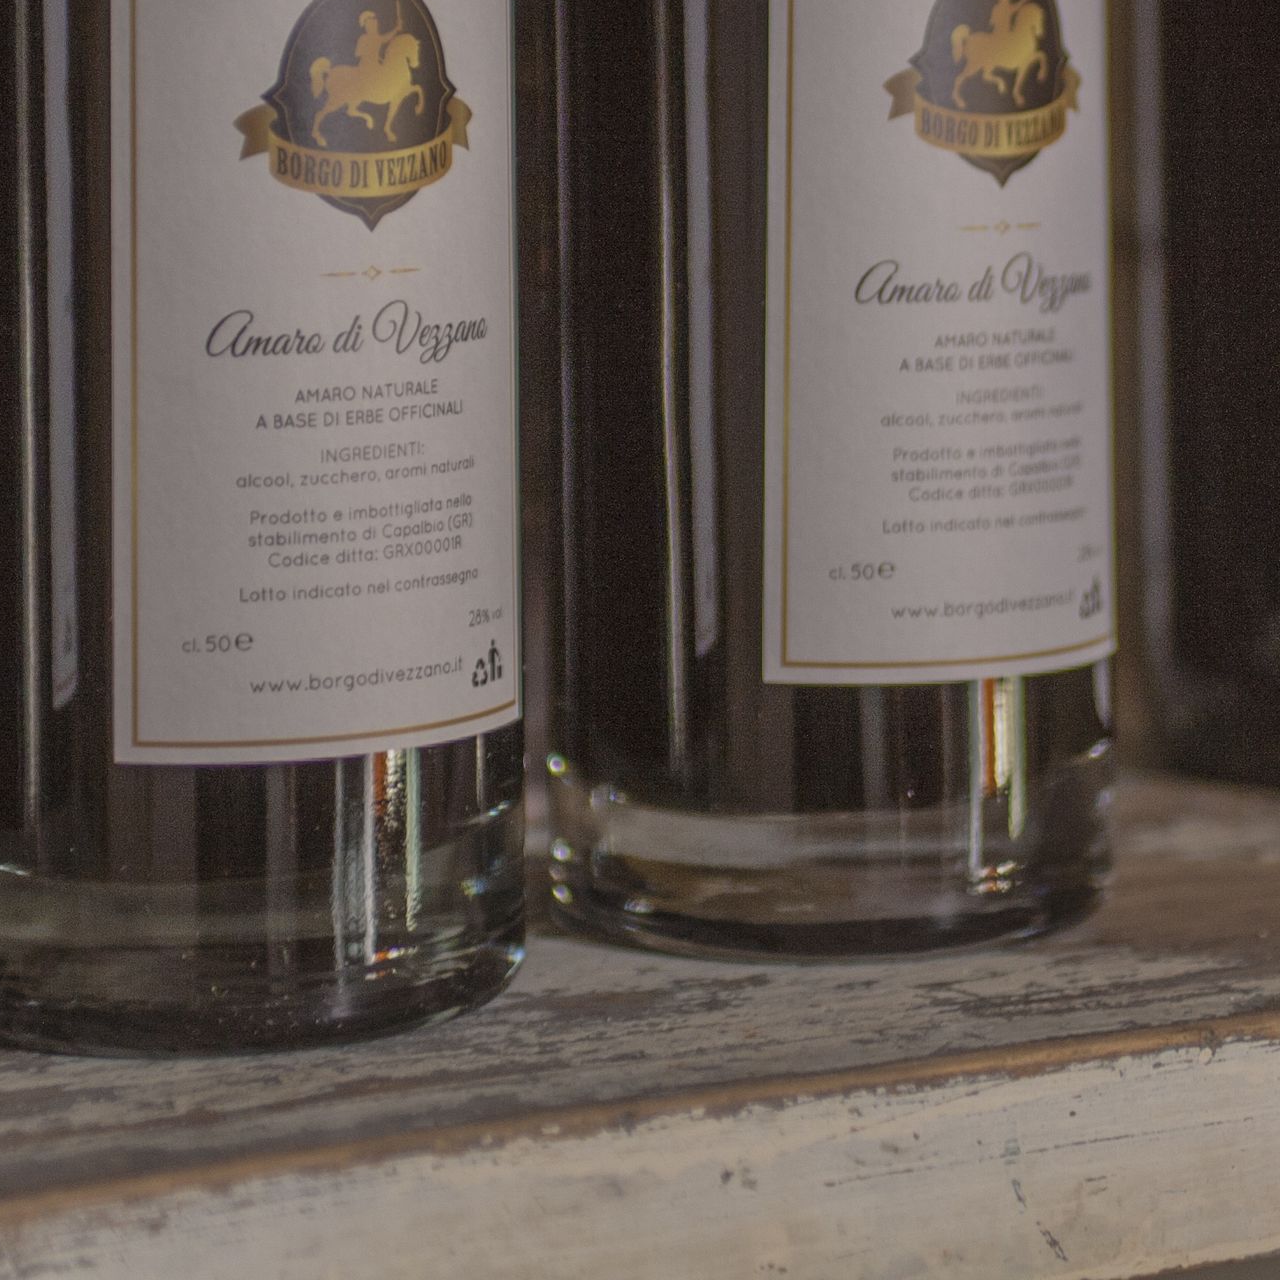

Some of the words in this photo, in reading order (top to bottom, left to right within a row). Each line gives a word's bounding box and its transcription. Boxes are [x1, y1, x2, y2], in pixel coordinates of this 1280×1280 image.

[984, 120, 1000, 148] DI
[276, 144, 343, 188] BORGO
[348, 160, 369, 190] DI
[374, 140, 448, 189] VEZZANO
[854, 259, 961, 305] Amaro
[967, 264, 995, 303] di
[205, 309, 326, 358] Amaro
[332, 314, 365, 354] di
[372, 299, 489, 365] Vezzano
[934, 331, 988, 350] AMARO
[899, 358, 911, 373] A
[914, 356, 954, 373] BASE
[958, 355, 974, 371] DI
[978, 352, 1012, 370] ERBE
[294, 386, 356, 405] AMARO
[361, 378, 438, 401] NATURALE
[255, 414, 268, 431] A
[273, 412, 317, 430] BASE
[322, 411, 340, 427] DI
[345, 407, 384, 426] ERBE
[388, 399, 464, 423] OFFICINALI
[319, 440, 426, 464] INGREDIENTI:
[892, 447, 962, 464] Prodotto
[235, 472, 296, 490] alcool,
[300, 467, 381, 487] zucchero,
[385, 462, 427, 480] aromi
[430, 455, 475, 476] naturali
[890, 466, 987, 484] stabilimento
[249, 508, 328, 526] Prodotto
[333, 510, 344, 522] e
[445, 492, 473, 512] nello
[907, 486, 964, 503] Codice
[248, 528, 357, 548] stabilimento
[362, 526, 377, 542] di
[382, 517, 445, 541] Capalbio
[447, 511, 474, 532] (GR)
[881, 519, 926, 535] Lotto
[929, 515, 991, 534] indicato
[267, 551, 331, 569] Codice
[335, 546, 379, 564] ditta:
[382, 535, 463, 562] GRX00001R
[239, 587, 286, 604] Lotto
[292, 580, 362, 601] indicato
[366, 579, 390, 596] nel
[394, 567, 480, 594] contrassegno
[249, 656, 464, 694] www.borgodivezzano.it
